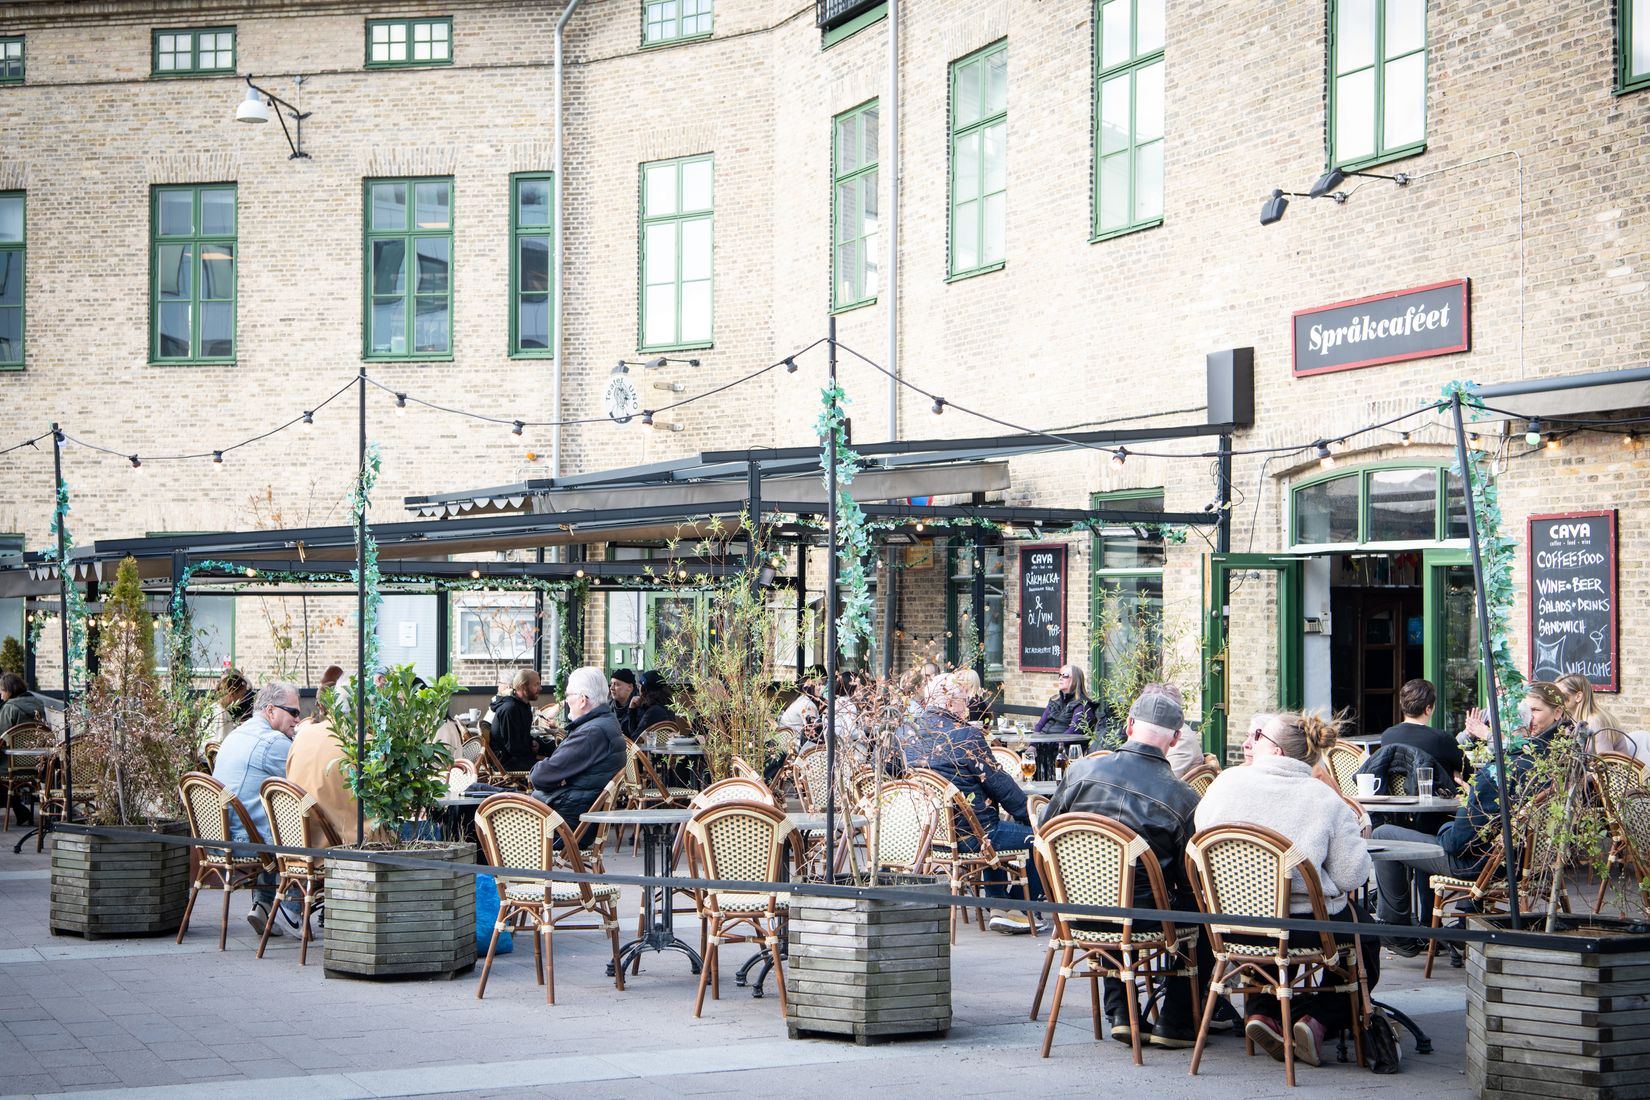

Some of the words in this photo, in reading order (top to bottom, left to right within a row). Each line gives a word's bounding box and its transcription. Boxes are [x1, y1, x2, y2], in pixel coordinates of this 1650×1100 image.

[1308, 302, 1450, 355] Språkcaféet
[628, 384, 639, 410] UNO
[1549, 523, 1591, 539] CAVA
[1031, 553, 1053, 564] CAVA
[1538, 618, 1586, 637] SANDWICH
[1566, 660, 1611, 677] WELCOME
